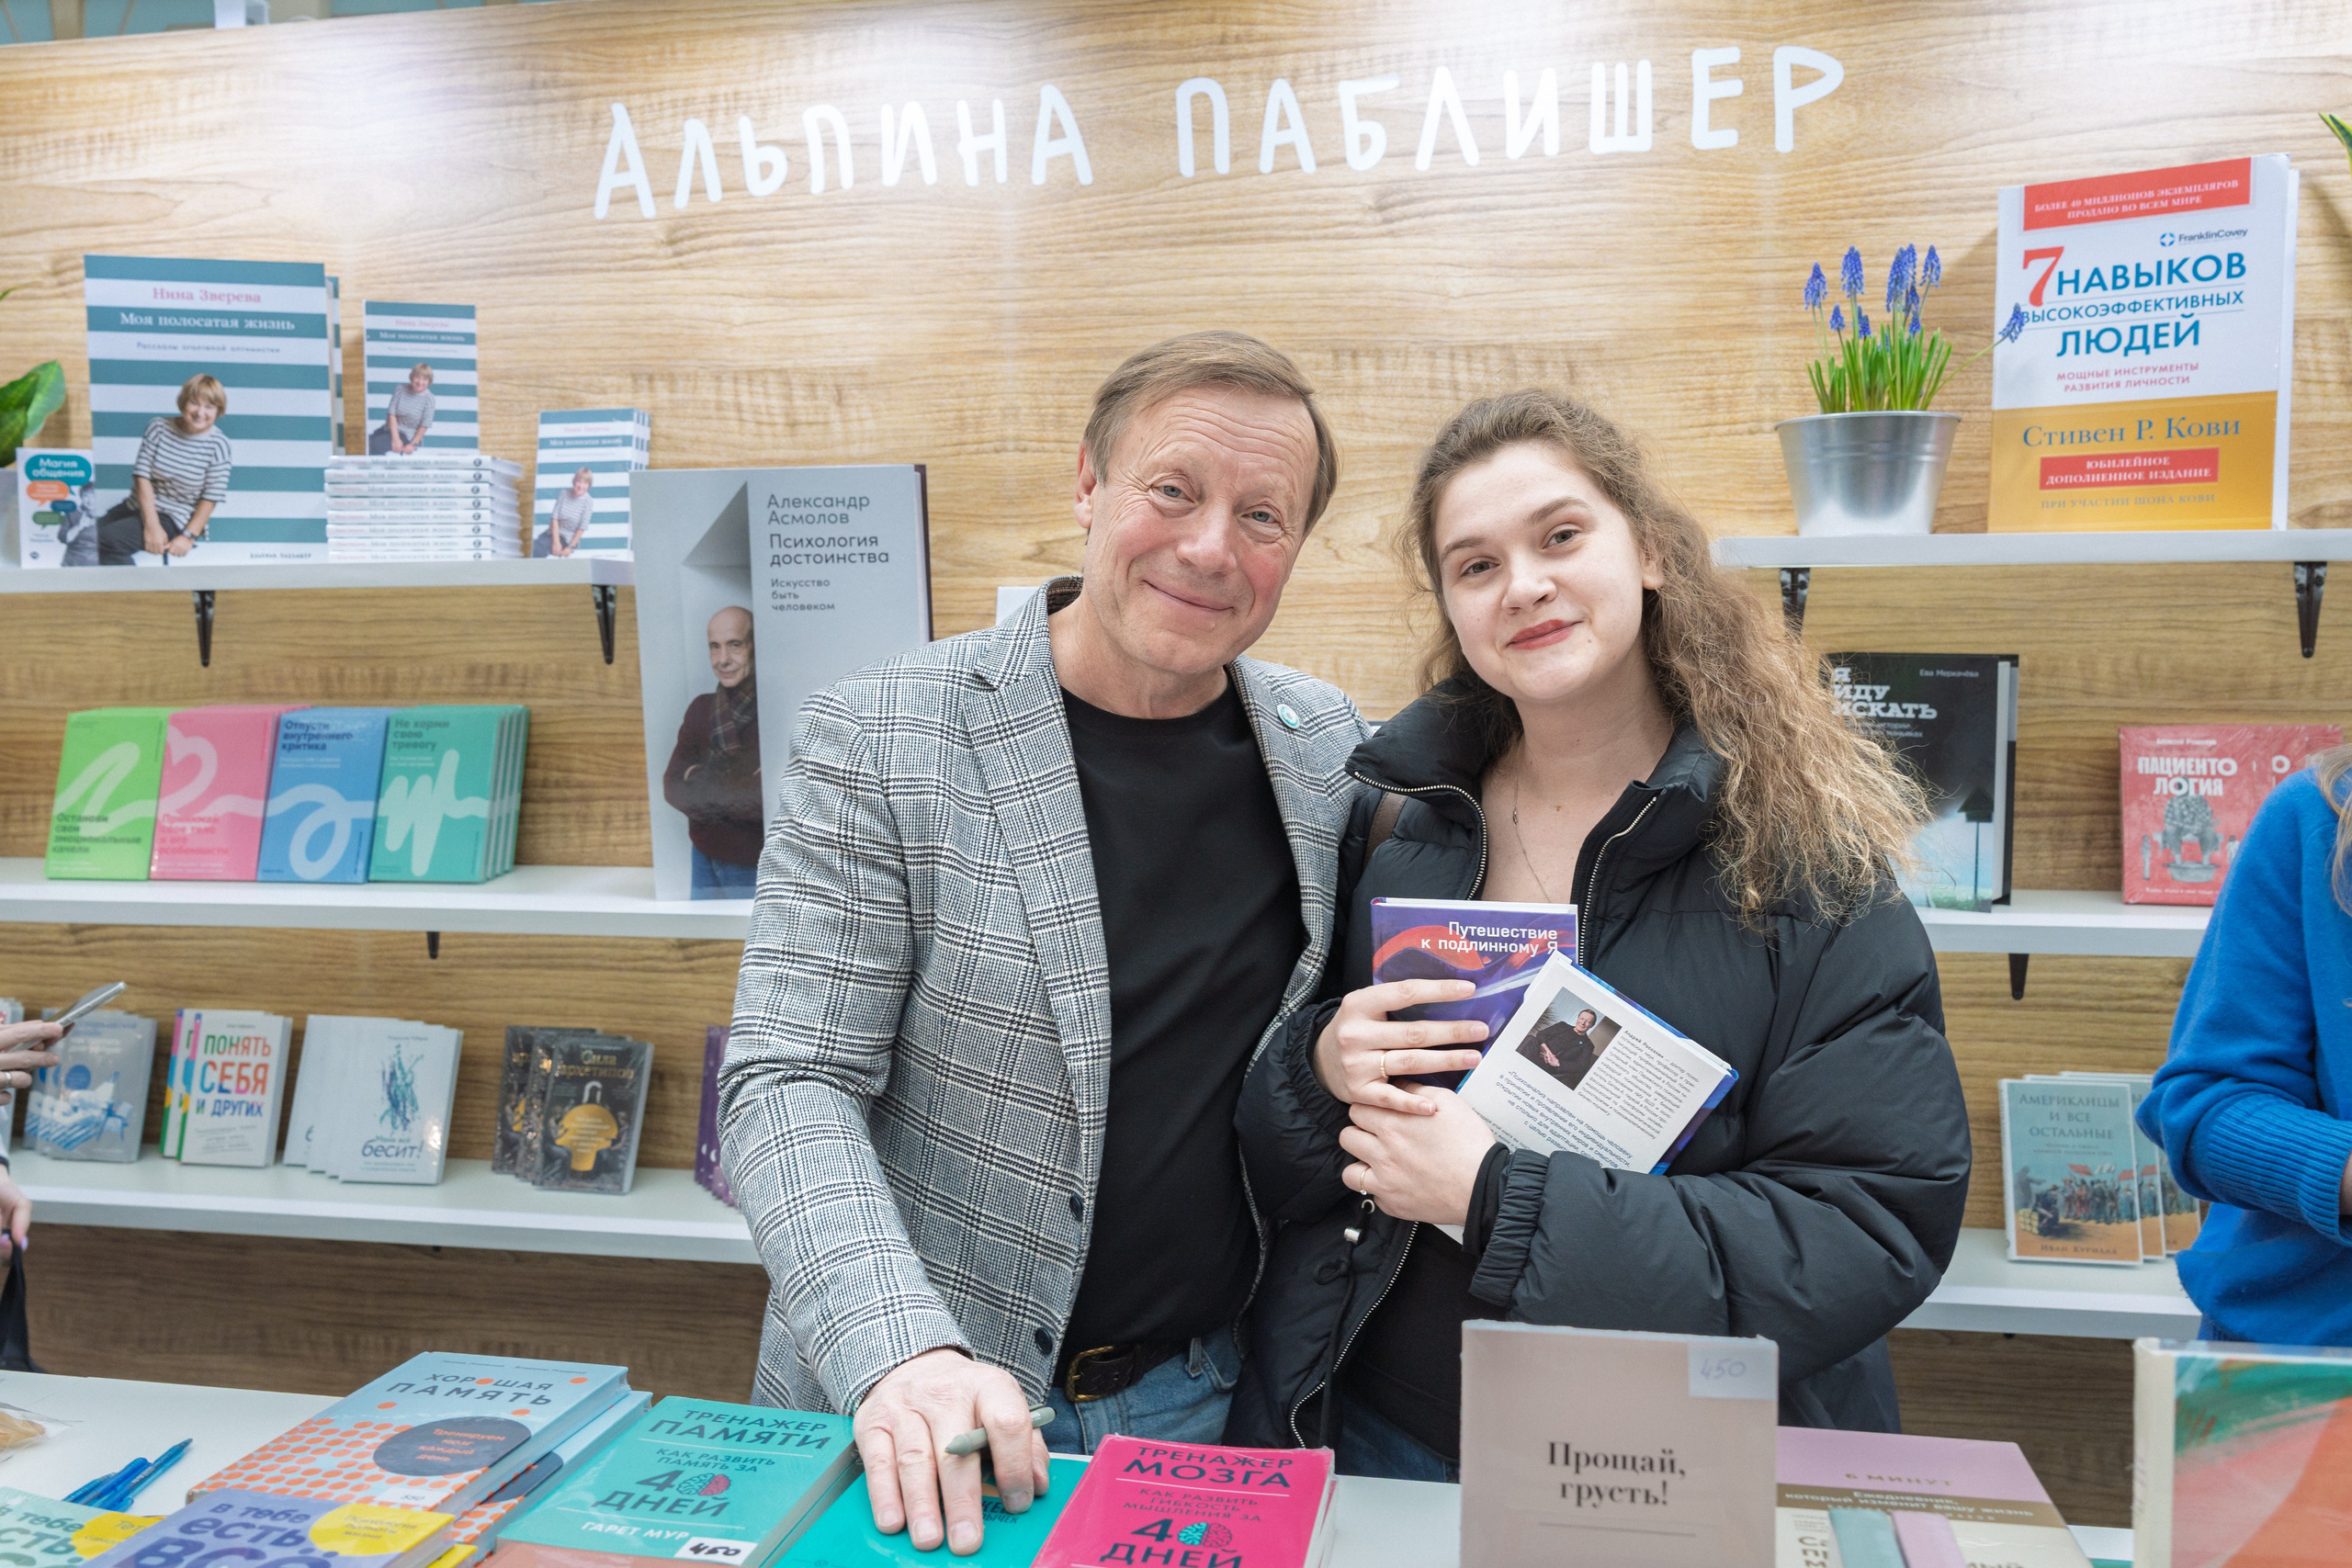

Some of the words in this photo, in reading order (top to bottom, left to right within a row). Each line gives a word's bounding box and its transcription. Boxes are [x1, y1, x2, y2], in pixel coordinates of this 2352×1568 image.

[594, 84, 1093, 220] АЛЬПИНА
[1176, 45, 1844, 177] ПАБЛИШЕР
[2035, 201, 2067, 212] БОЛЕЕ
[2070, 199, 2082, 208] 40
[2084, 190, 2154, 207] МИЛЛИОНОВ
[2156, 179, 2239, 197] ЭКЗЕМПЛЯРОВ
[2067, 206, 2120, 219] ПРОДАНО
[2121, 203, 2137, 212] ВО
[2139, 199, 2169, 210] ВСЕМ
[2171, 195, 2202, 207] МИРЕ
[2178, 229, 2248, 243] FranklinCovey
[2023, 246, 2064, 307] 7
[2057, 253, 2246, 296] НАВЫКОВ
[153, 288, 194, 300] Нина
[199, 289, 261, 304] Зверева
[2022, 290, 2244, 323] ВЫСОКОЭФФЕКТИВНЫХ
[120, 312, 153, 326] Моя
[159, 315, 239, 329] полосатая
[244, 319, 295, 330] жизнь
[2056, 312, 2200, 357] ЛЮДЕЙ
[2057, 368, 2110, 381] МОЩНЫЕ
[2114, 363, 2199, 376] ИНСТРУМЕНТЫ
[2064, 381, 2120, 392] РАЗВИТИЯ
[2125, 376, 2190, 388] ЛИЧНОСТИ
[2023, 425, 2125, 447] Стивен
[2135, 419, 2154, 441] Р.
[2165, 417, 2241, 439] Кови
[2086, 456, 2170, 469] ЮБИЛЕЙНОЕ
[2045, 470, 2145, 485] ДОПОЛНЕННОЕ
[2149, 468, 2211, 480] ИЗДАНИЕ
[767, 493, 870, 512] Александр
[768, 511, 849, 525] Асмолов
[770, 534, 878, 548] Психология
[770, 551, 889, 568] достоинства
[771, 578, 831, 588] Искусство
[772, 589, 799, 600] быть
[772, 602, 835, 611] человеком
[1919, 669, 1934, 677] Ева
[1834, 684, 1891, 702] ИДУ
[1832, 702, 1938, 719] ИСКАТЬ
[285, 720, 330, 732] Отпусти
[394, 719, 410, 728] Не
[414, 720, 450, 730] корми
[283, 731, 354, 741] внутреннего
[282, 742, 327, 753] критика
[392, 740, 436, 751] тревогу
[2138, 757, 2238, 777] ПАЦИЕНТО
[2153, 776, 2223, 796] ЛОГИЯ
[1449, 921, 1557, 940] Путешествие
[1421, 939, 1431, 949] к
[1438, 939, 1539, 958] подлинному
[1547, 941, 1558, 954] Я
[204, 1034, 272, 1056] ПОНЯТЬ
[1623, 1029, 1642, 1043] Андрей
[199, 1061, 269, 1095] СЕБЯ
[196, 1099, 206, 1114] И
[211, 1099, 264, 1117] ДРУГИХ
[2018, 1094, 2120, 1108] АМЕРИКАНЦЫ
[1495, 1079, 1522, 1101] открытии
[1521, 1099, 1540, 1113] новых
[1538, 1111, 1571, 1136] внутренних
[1570, 1133, 1589, 1148] миров
[1592, 1149, 1618, 1169] смыслов
[1503, 1076, 1531, 1098] принятии
[1534, 1098, 1568, 1124] проявлении
[1566, 1121, 1578, 1131] его
[1577, 1128, 1631, 1168] индивидуальности,
[1506, 1098, 1515, 1107] не
[1514, 1103, 1538, 1122] столько
[1536, 1119, 1550, 1131] для
[1548, 1127, 1580, 1152] адаптации,
[2050, 1111, 2059, 1122] И
[2067, 1111, 2092, 1122] ВСЕ
[1527, 1122, 1546, 1139] целью
[1545, 1096, 1577, 1120] направлен
[1575, 1116, 1584, 1125] на
[1583, 1122, 1607, 1141] помощь
[1605, 1137, 1633, 1159] человеку
[2029, 1126, 2113, 1139] ОСТАЛЬНЫЕ
[362, 1139, 424, 1158] бесит!
[1701, 1358, 1746, 1381] 450
[385, 1382, 553, 1405] ПАМЯТЬ
[684, 1409, 828, 1432] ТРЕНАЖЕР
[649, 1420, 832, 1450] ПАМЯТИ
[418, 1445, 475, 1455] каждый
[656, 1448, 693, 1459] КАК
[698, 1452, 775, 1466] РАЗВИТЬ
[1137, 1447, 1294, 1468] ТРЕНАЖЕР
[657, 1458, 730, 1472] ПАМЯТЬ
[734, 1463, 758, 1472] ЗА
[1547, 1441, 1686, 1479] Прощай,
[1123, 1460, 1292, 1488] МОЗГА
[1867, 1474, 1953, 1486] МИНУТ
[1139, 1489, 1172, 1498] КАК
[1182, 1493, 1259, 1506] РАЗВИТЬ
[1560, 1480, 1668, 1508] грусть!
[1853, 1491, 1959, 1506] Ежедневник,
[593, 1491, 731, 1517] ДНЕЙ
[1123, 1503, 1231, 1519] МЫШЛЕНИЯ
[1150, 1497, 1240, 1512] ГИБКОСТЬ
[1785, 1493, 1853, 1505] который
[1859, 1498, 1928, 1509] изменит
[1933, 1504, 1975, 1514] вашу
[1981, 1506, 2034, 1517] жизнь
[17, 1512, 85, 1532] тебе
[209, 1504, 234, 1514] в
[238, 1506, 312, 1524] тебе
[345, 1515, 418, 1529] Психология
[178, 1517, 307, 1547] есть
[581, 1521, 639, 1536] ГАРЕТ
[643, 1528, 690, 1540] МУР
[0, 1527, 76, 1554] сть
[1099, 1542, 1244, 1568] ДНЕЙ
